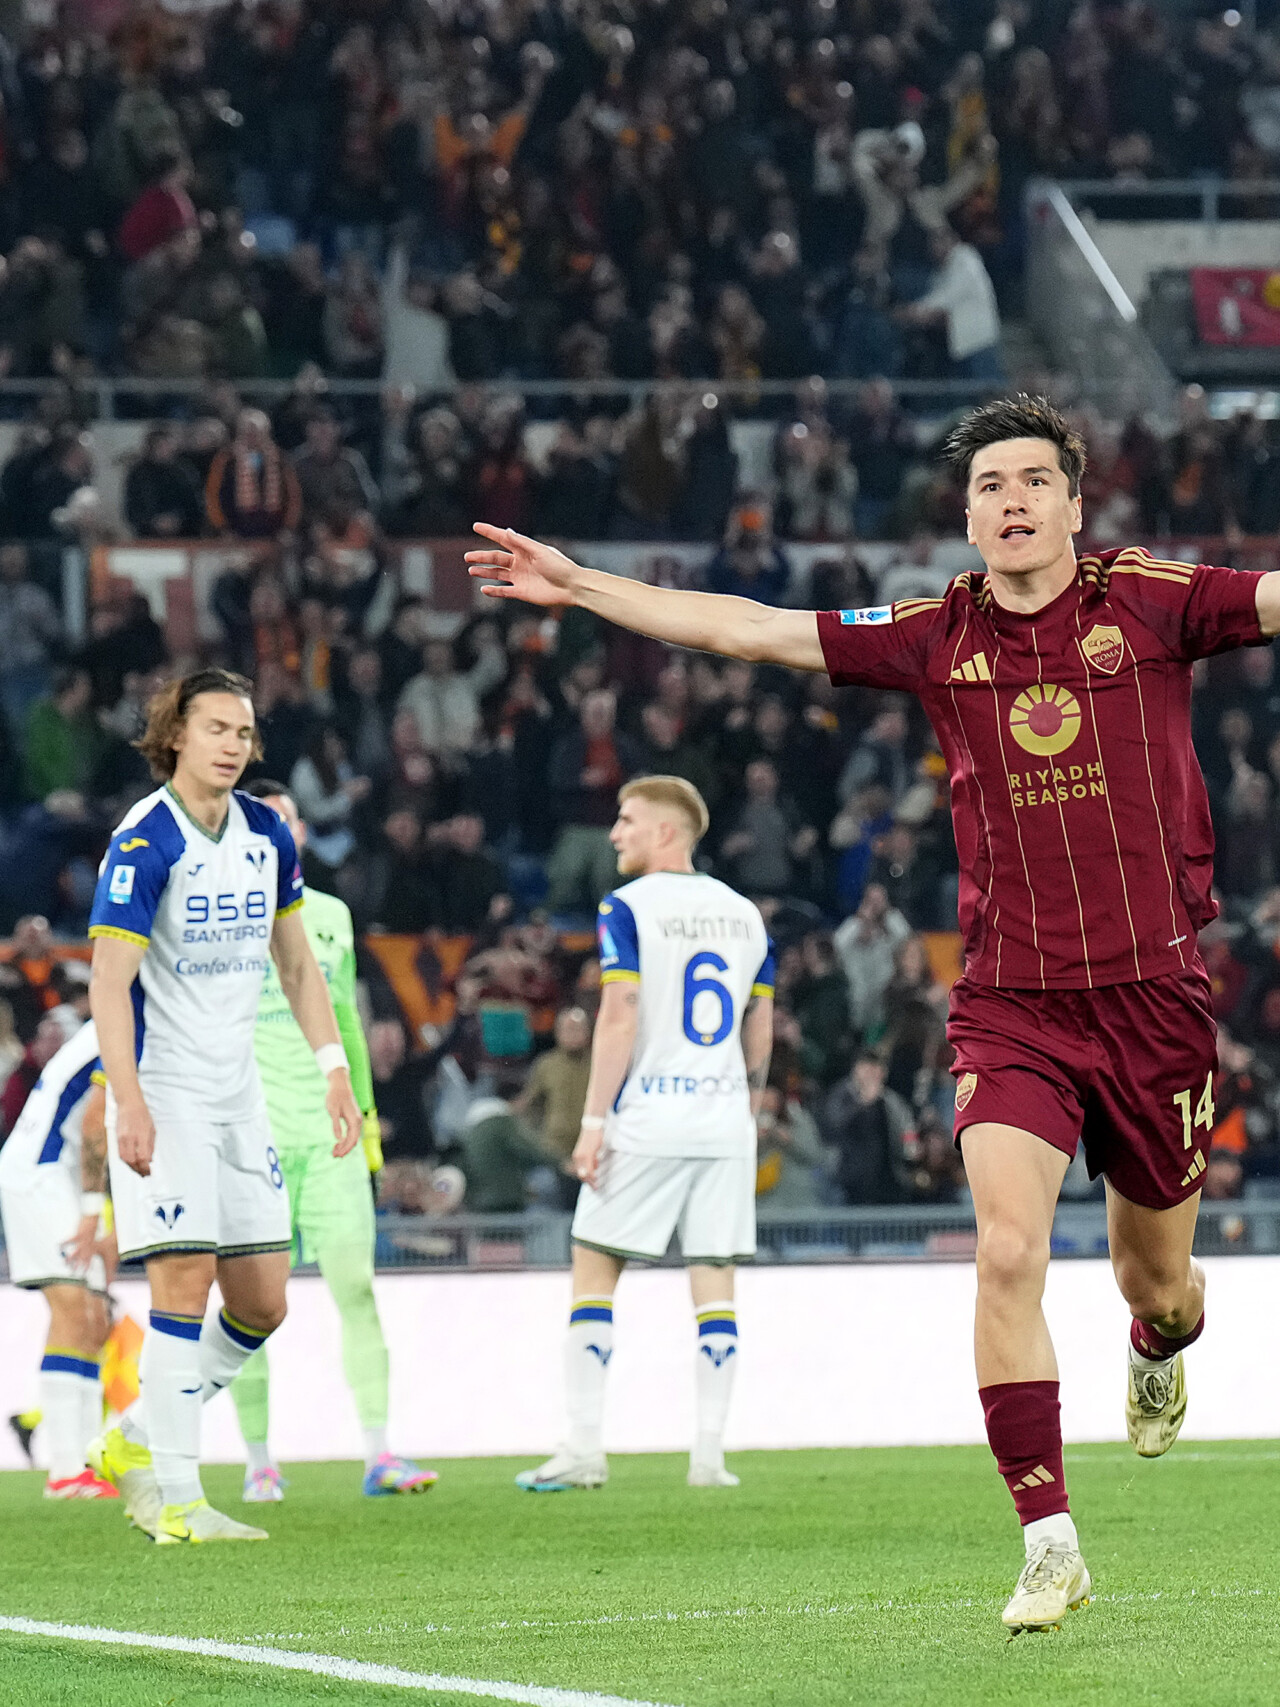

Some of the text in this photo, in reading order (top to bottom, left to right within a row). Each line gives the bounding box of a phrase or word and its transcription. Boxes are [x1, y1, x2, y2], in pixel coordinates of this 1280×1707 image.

[1094, 648, 1120, 664] ROMA
[1010, 762, 1102, 788] RIYADH
[1013, 780, 1105, 808] SEASON
[183, 925, 268, 943] SANTERO
[683, 951, 734, 1047] 6
[1173, 1070, 1215, 1150] 14
[266, 1146, 283, 1190] 8
